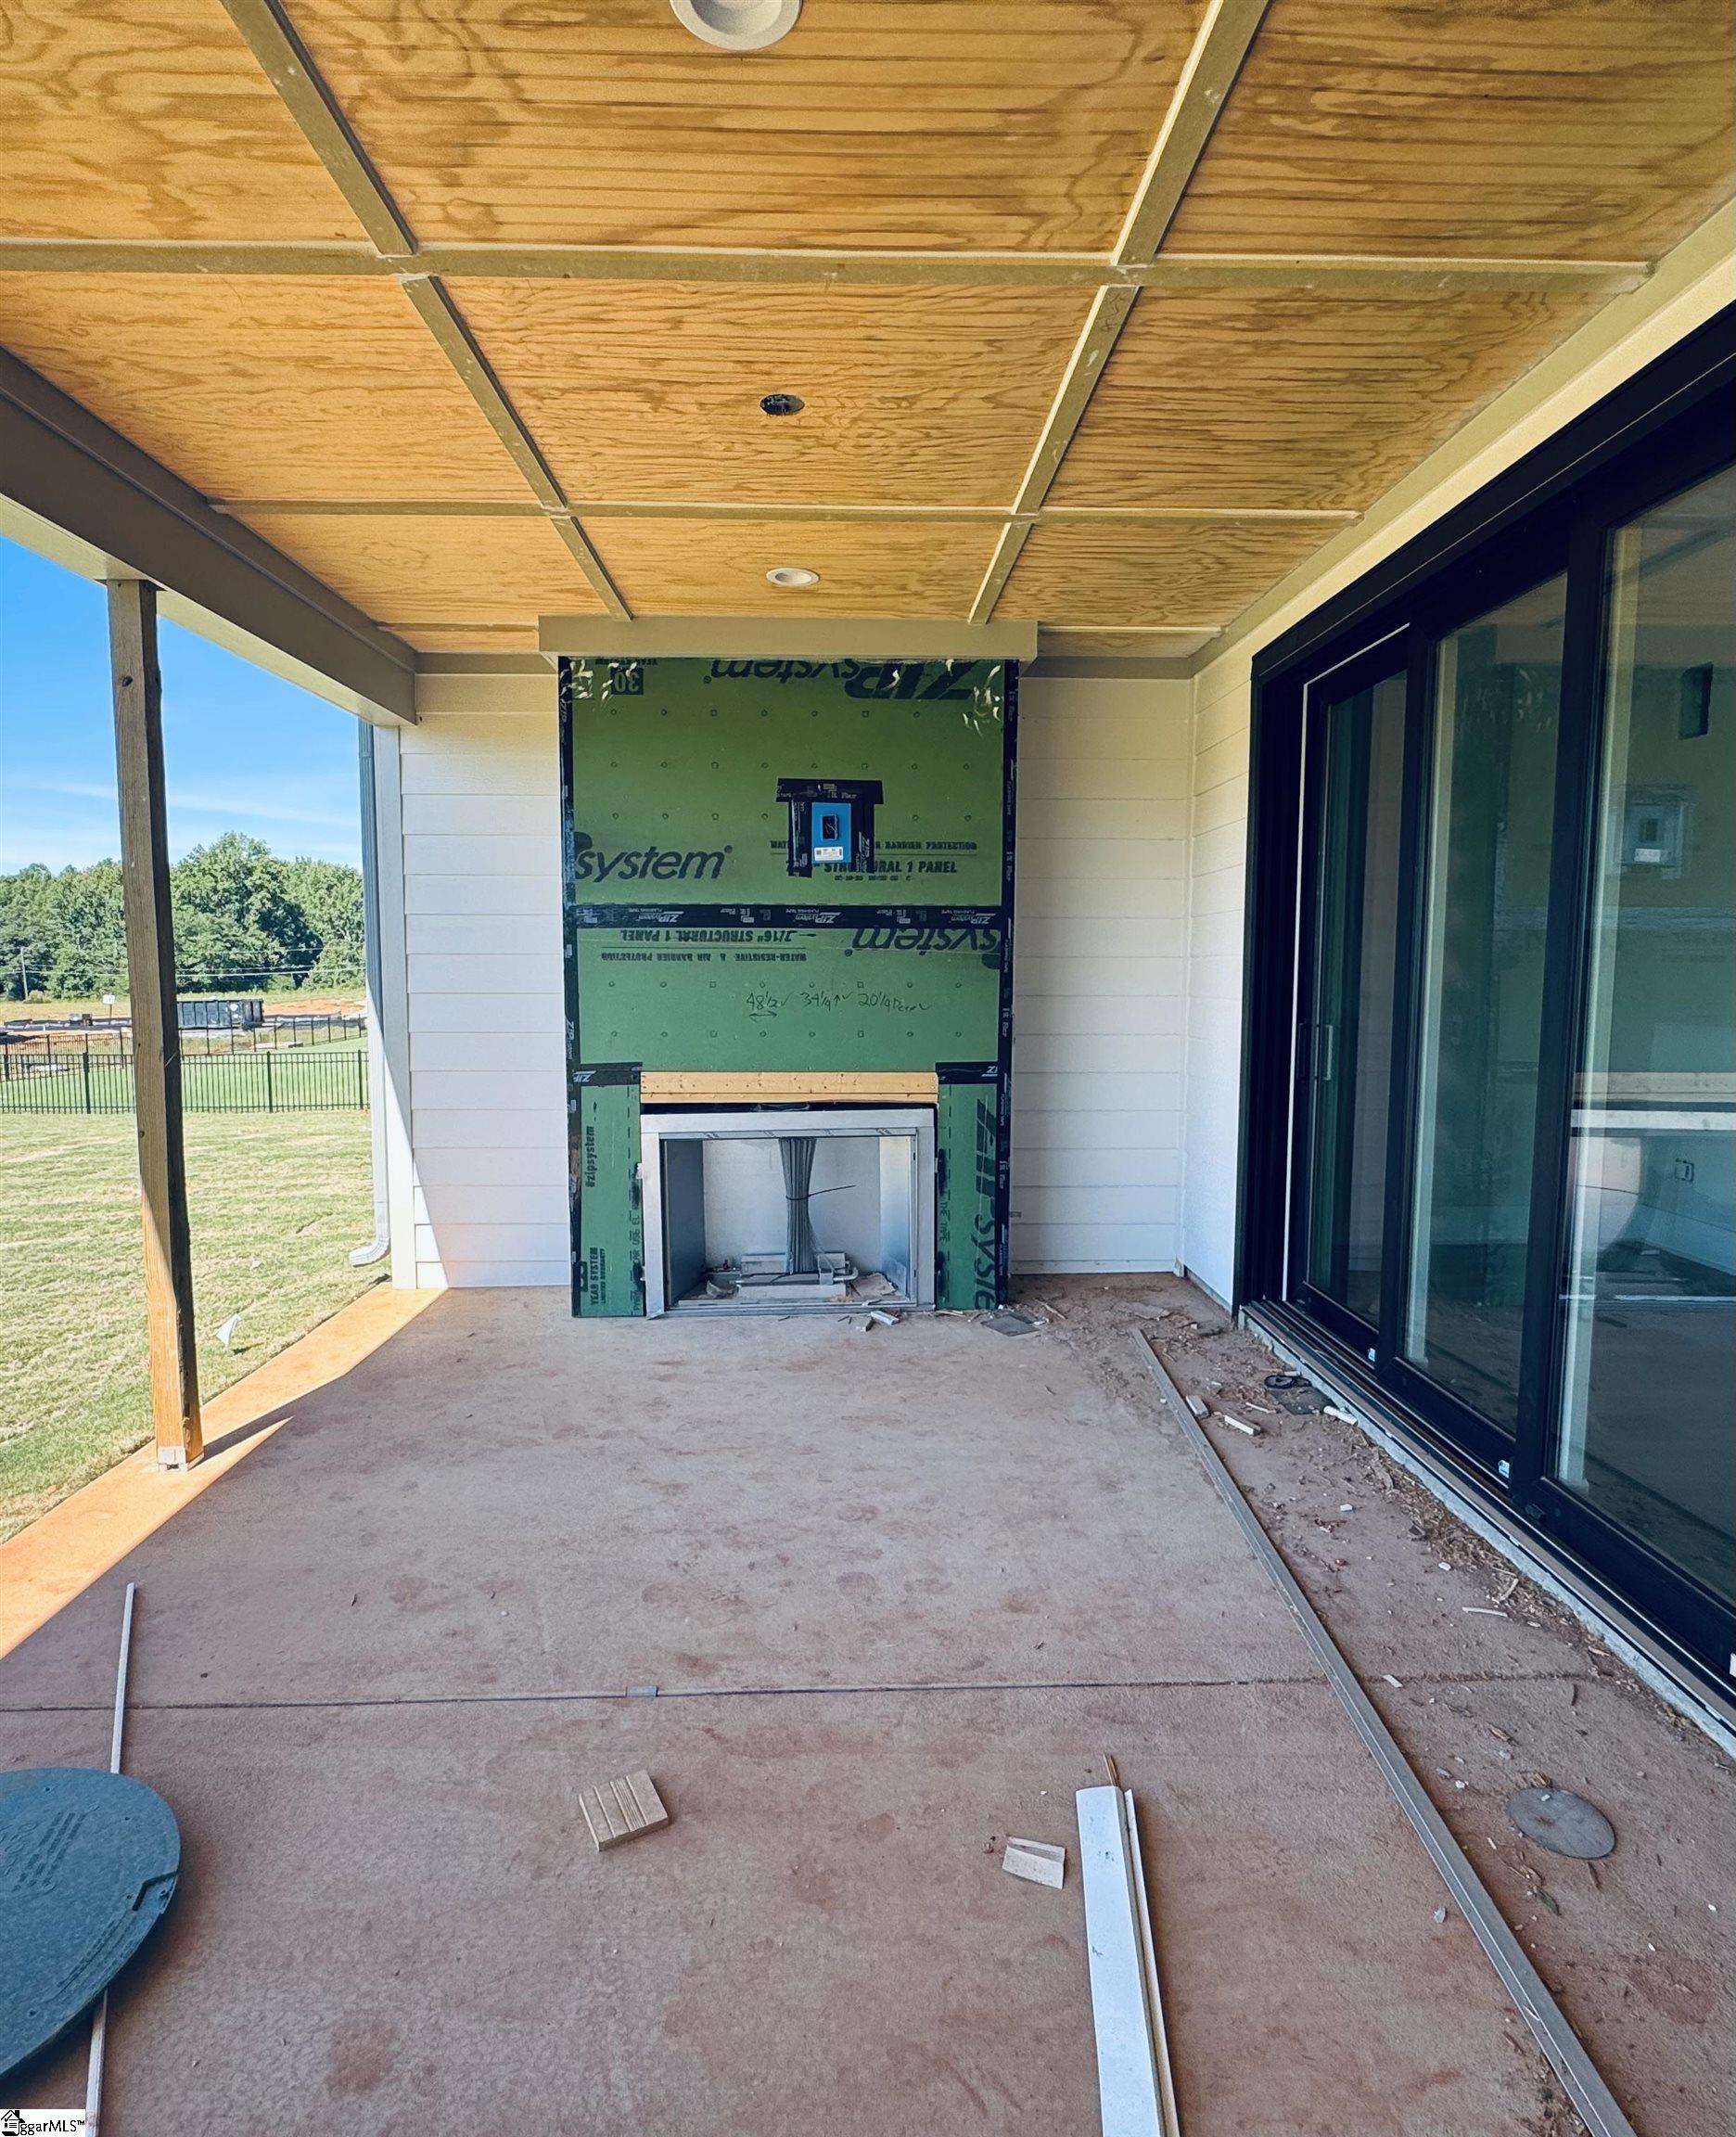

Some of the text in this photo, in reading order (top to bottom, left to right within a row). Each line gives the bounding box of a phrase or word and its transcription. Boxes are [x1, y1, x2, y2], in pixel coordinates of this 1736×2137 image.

[918, 861, 958, 873] PANEL
[620, 929, 660, 941] PANEL
[676, 929, 753, 942] STRUCTURAL
[939, 1223, 948, 1242] TAPE
[589, 1247, 599, 1306] YEAR SYSTEM
